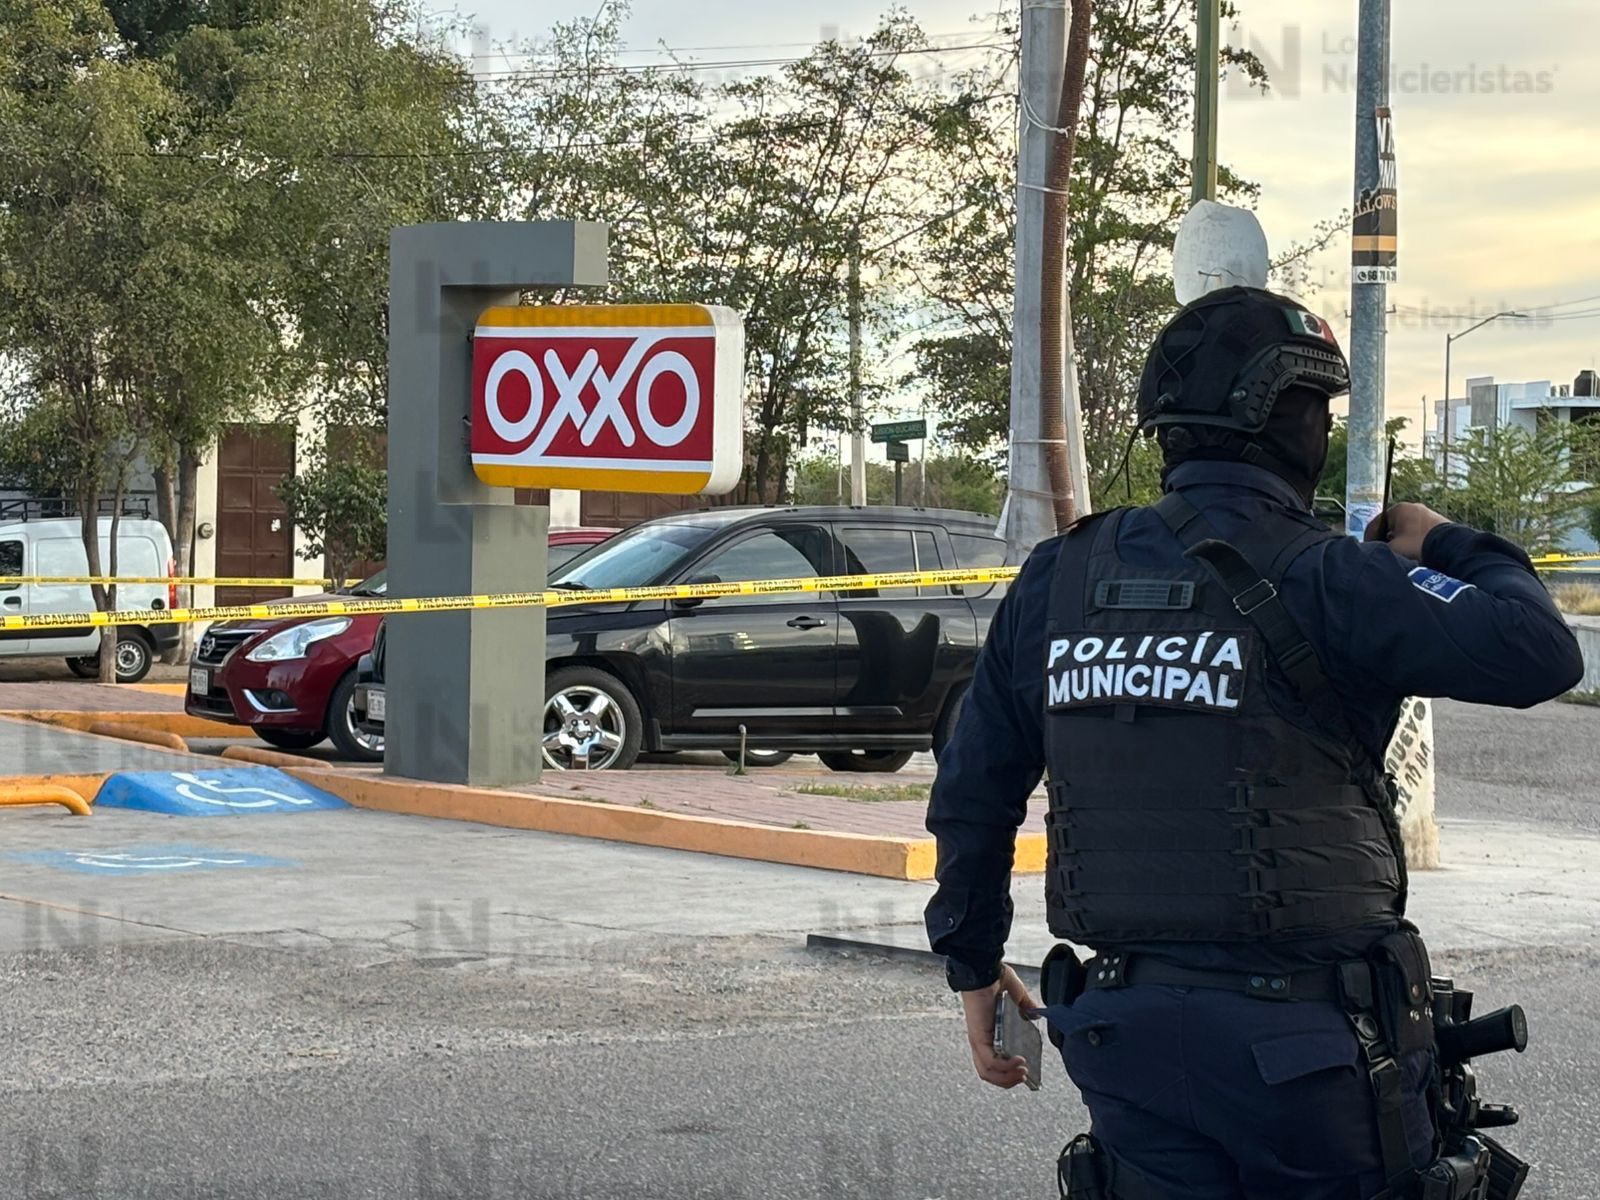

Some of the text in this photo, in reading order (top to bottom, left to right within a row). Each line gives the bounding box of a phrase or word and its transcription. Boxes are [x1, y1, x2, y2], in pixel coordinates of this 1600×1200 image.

[485, 345, 700, 452] OXXO
[22, 613, 91, 627] PRECAUCION
[107, 610, 173, 623] PRECAUCION
[188, 607, 252, 619] PRECAUCION
[266, 603, 329, 616] PRECAUCION
[1047, 632, 1242, 670] POLICÍA
[1048, 664, 1239, 708] MUNICIPAL
